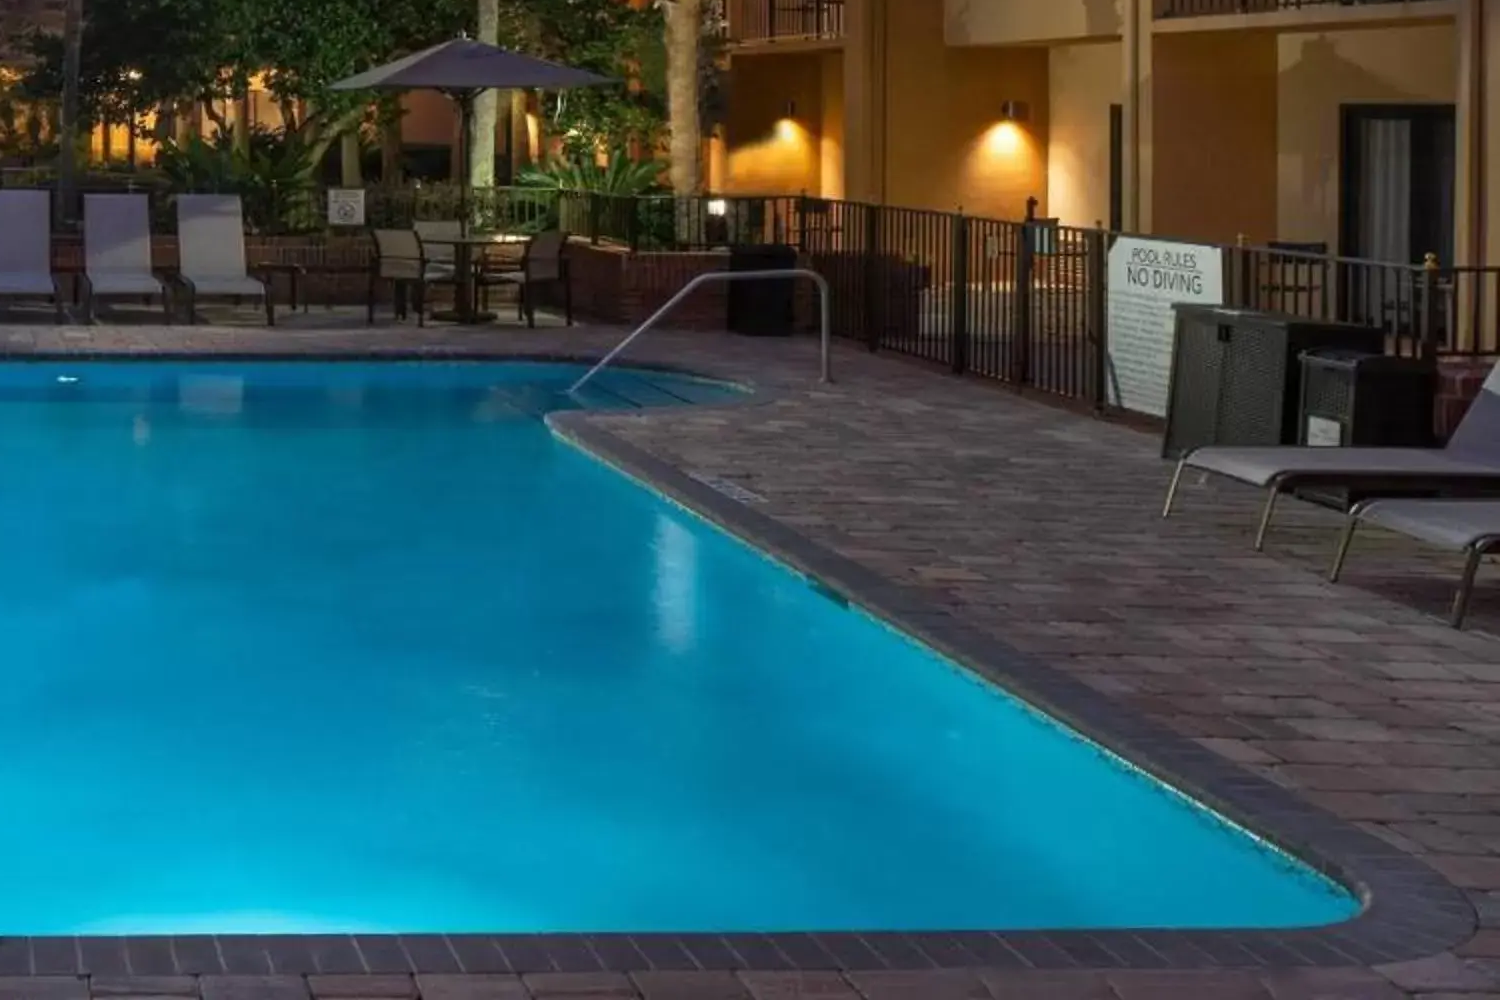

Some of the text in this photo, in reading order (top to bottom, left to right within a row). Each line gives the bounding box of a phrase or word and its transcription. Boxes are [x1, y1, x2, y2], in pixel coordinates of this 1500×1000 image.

[1132, 247, 1197, 269] POOL RULES
[1126, 266, 1203, 294] NO DIVING
